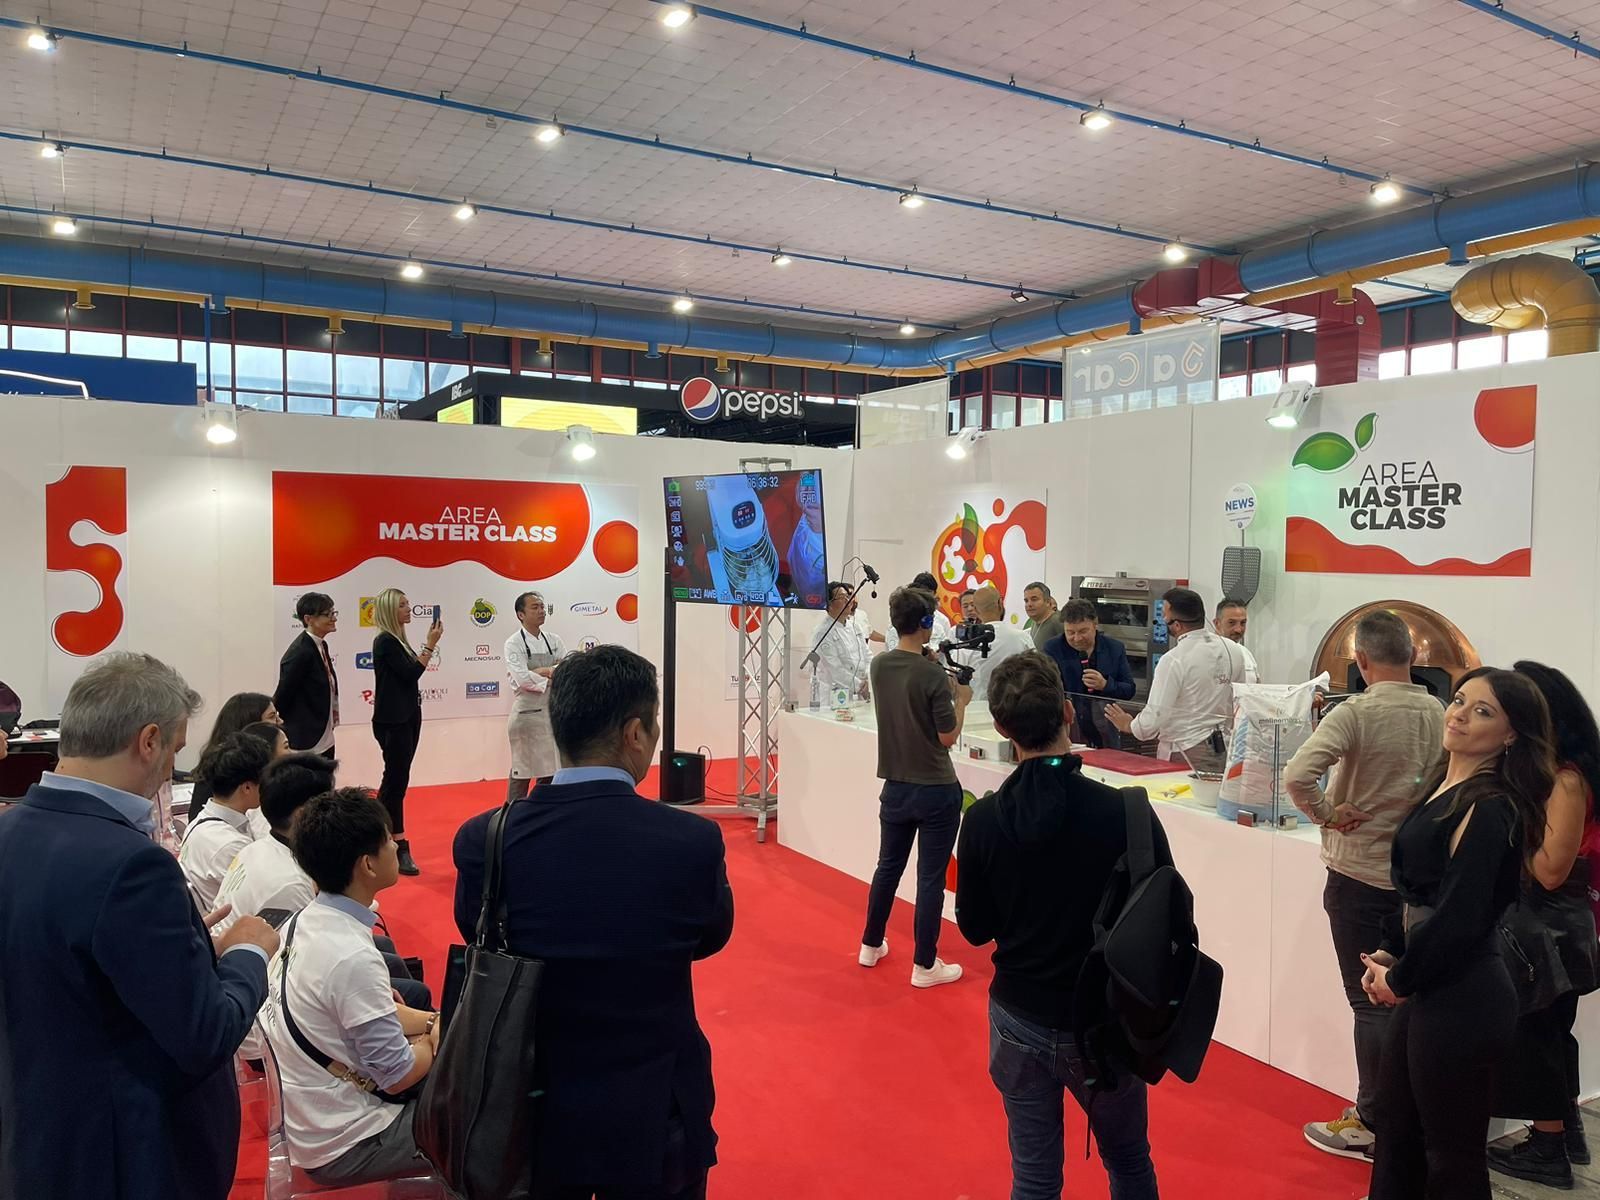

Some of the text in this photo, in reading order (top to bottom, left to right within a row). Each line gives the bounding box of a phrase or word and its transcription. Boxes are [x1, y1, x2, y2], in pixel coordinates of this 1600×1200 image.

[725, 391, 799, 419] pepsi
[1359, 461, 1439, 486] AREA
[1225, 497, 1255, 512] NEWS
[1338, 483, 1462, 509] MASTER
[439, 506, 502, 524] AREA
[1350, 507, 1446, 530] CLASS
[379, 522, 557, 543] MASTER CLASS
[475, 611, 491, 619] DOP
